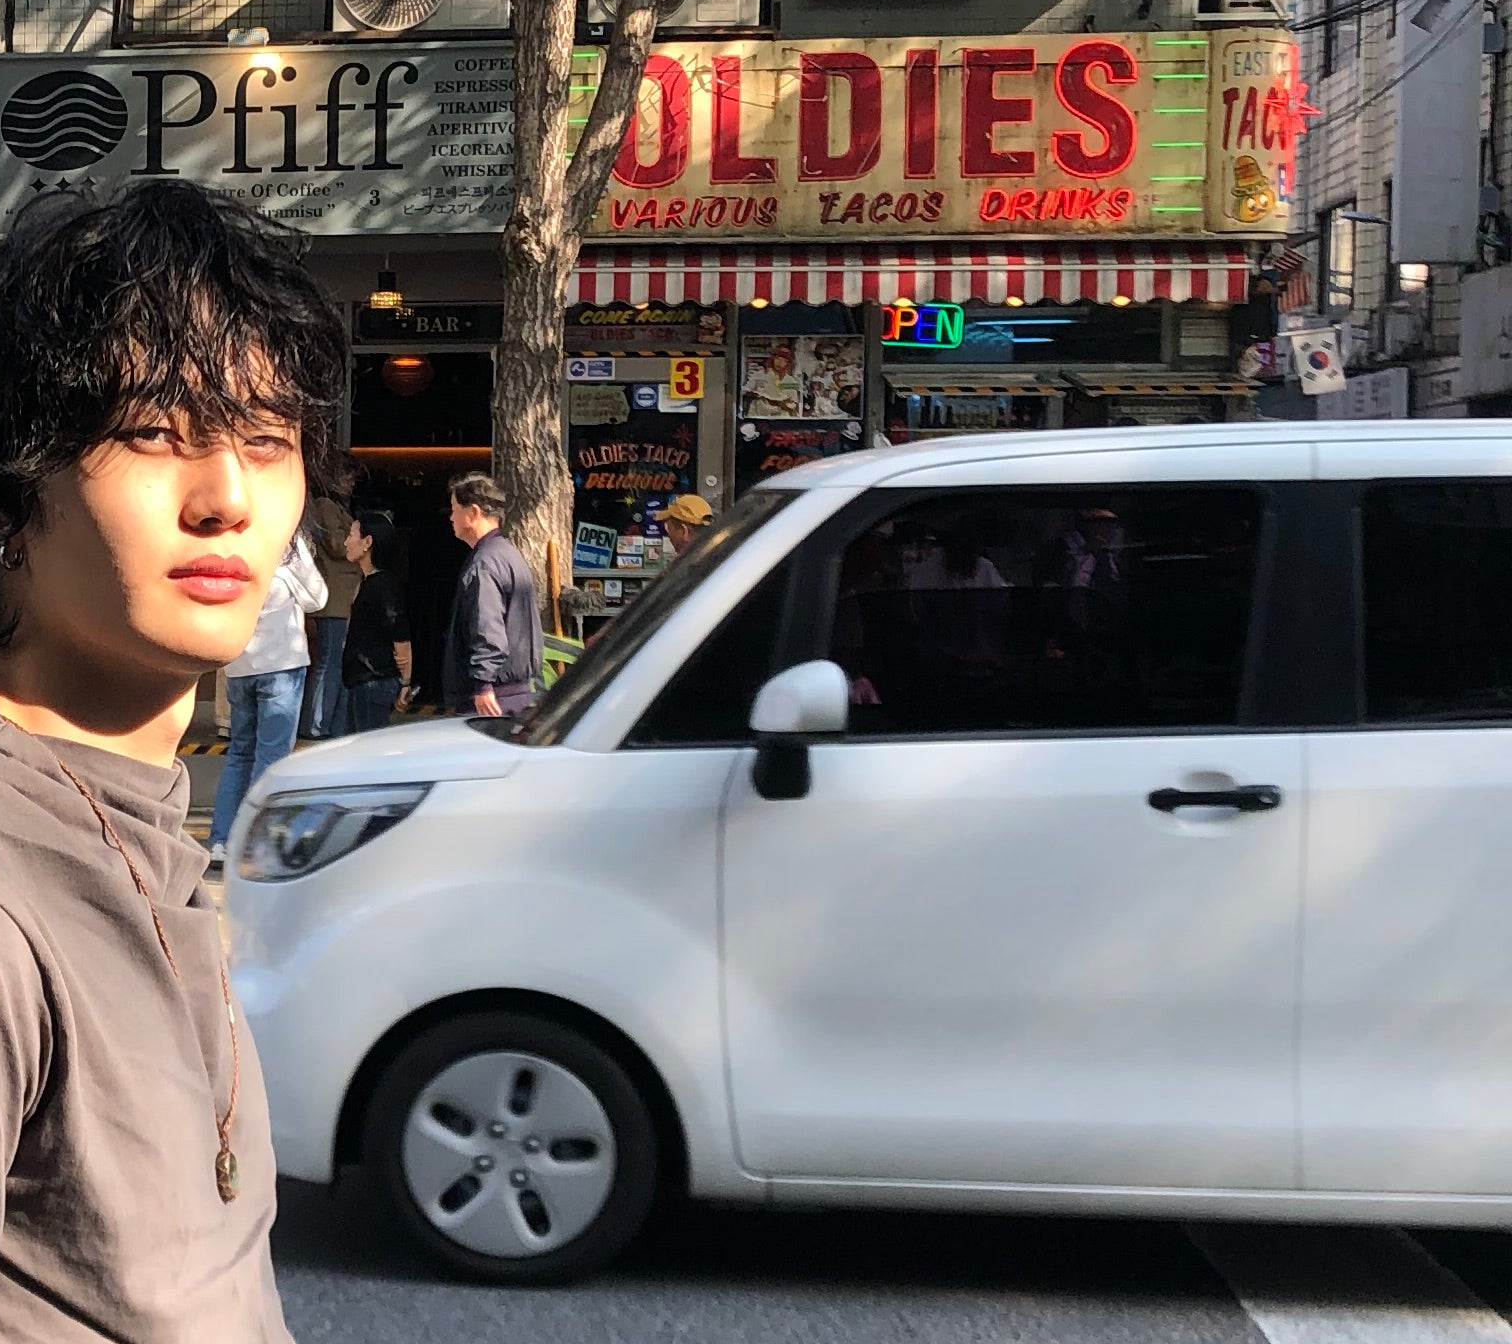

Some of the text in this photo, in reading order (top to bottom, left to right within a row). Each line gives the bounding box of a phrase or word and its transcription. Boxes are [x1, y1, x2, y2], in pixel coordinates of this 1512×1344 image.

[130, 60, 419, 176] Pfiff
[610, 39, 1139, 189] OLDIES
[250, 182, 273, 198] Of
[276, 182, 332, 198] Coffee
[368, 188, 382, 207] 3
[609, 186, 1136, 229] VARIOUS TACOS DRINKS
[415, 316, 461, 333] BAR
[578, 309, 635, 325] COME
[674, 360, 700, 396] 3
[578, 442, 691, 469] OLDIES TACO
[584, 470, 679, 491] DELICIOUS
[578, 526, 616, 548] OPEN
[620, 556, 642, 566] VISA
